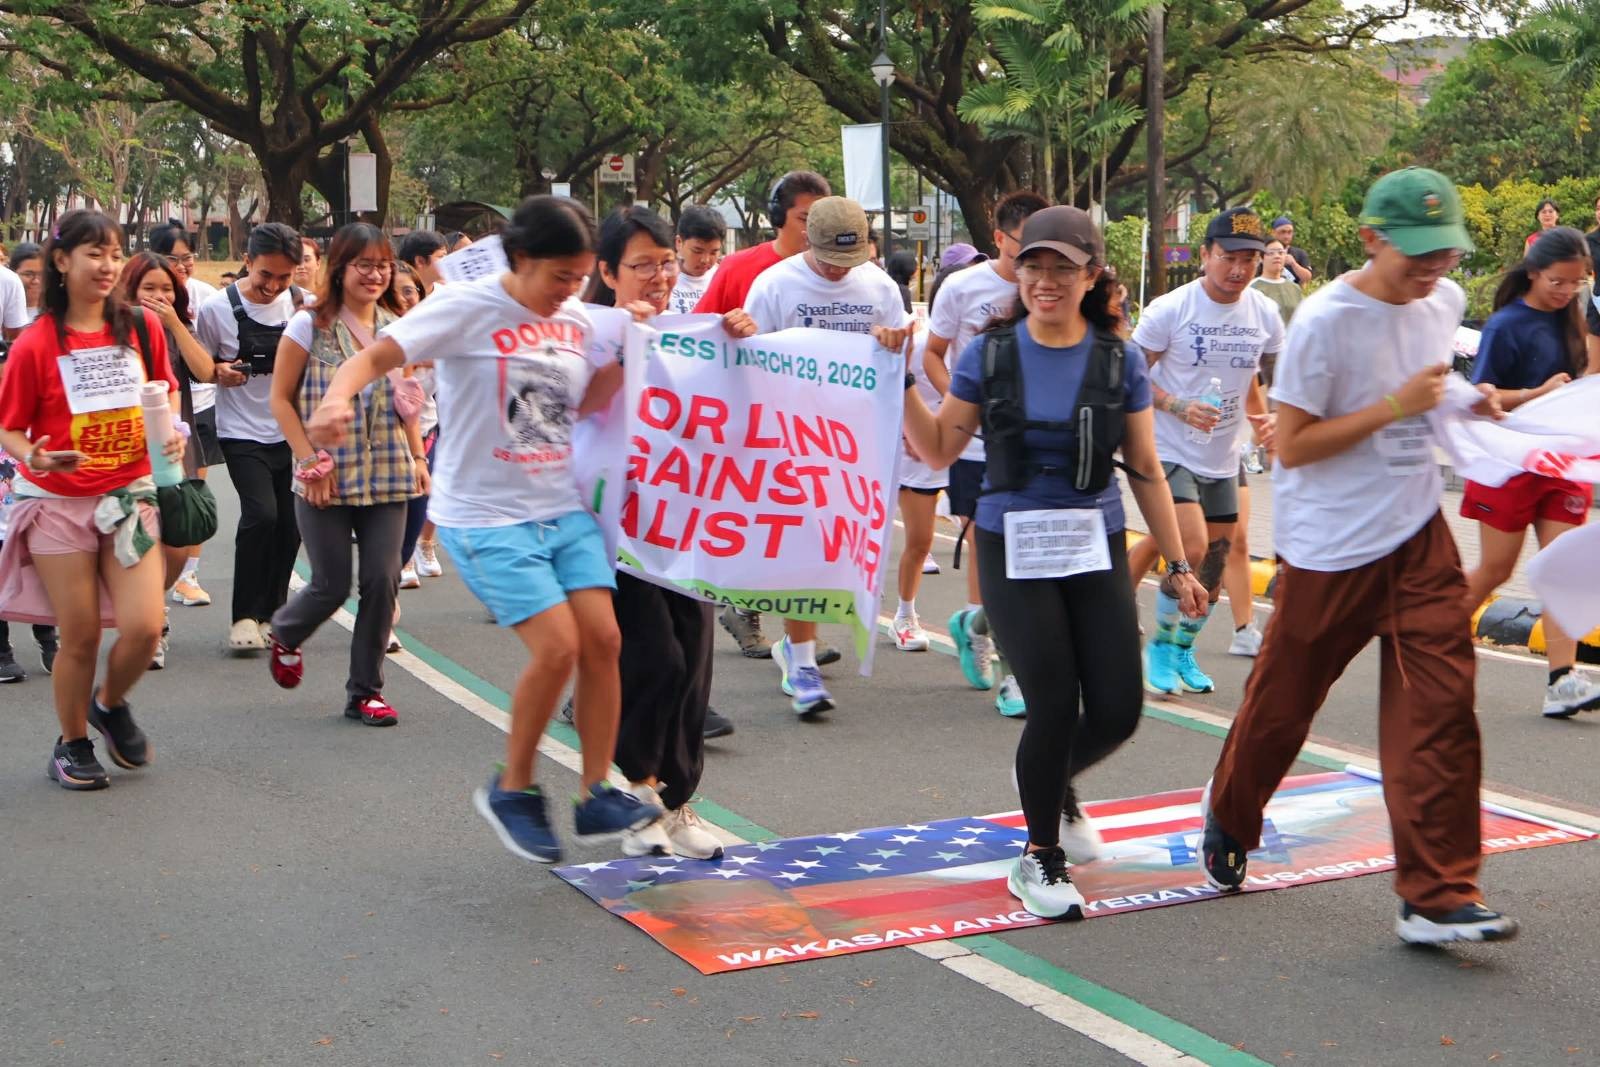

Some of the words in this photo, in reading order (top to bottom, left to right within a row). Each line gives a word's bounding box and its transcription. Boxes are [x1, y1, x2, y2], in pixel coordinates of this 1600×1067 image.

[818, 319, 872, 335] Running
[1210, 339, 1259, 356] Running
[74, 360, 129, 374] REPORMA
[80, 374, 95, 383] SA
[736, 347, 793, 376] MARCH
[797, 356, 823, 387] 29,
[828, 361, 877, 391] 2026
[637, 386, 729, 444] OR
[625, 434, 830, 509] GAINST
[840, 469, 886, 530] US
[620, 490, 805, 560] ALIST
[819, 515, 881, 593] WAR
[719, 924, 944, 966] WAKASAN
[953, 912, 1041, 933] ANG
